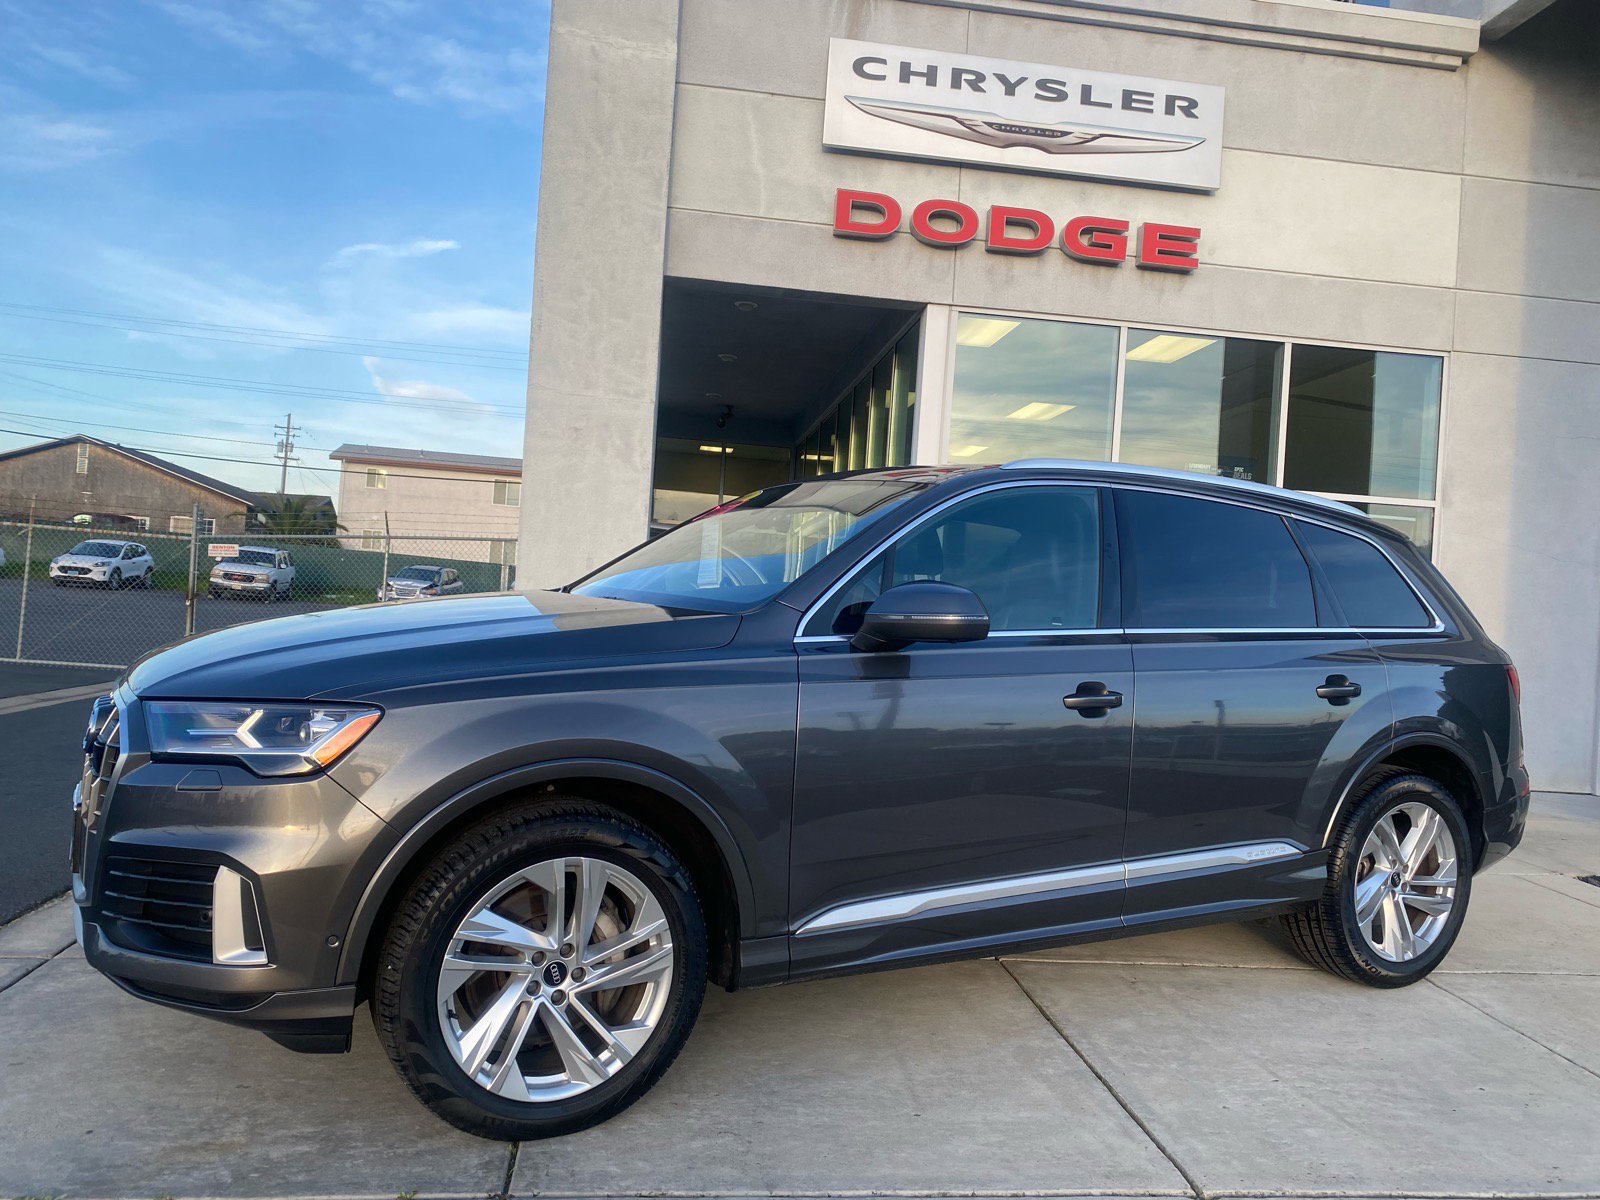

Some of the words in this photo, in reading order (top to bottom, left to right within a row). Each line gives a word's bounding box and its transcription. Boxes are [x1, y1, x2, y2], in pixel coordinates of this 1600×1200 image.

[852, 56, 1200, 119] CHRYSLER
[992, 124, 1061, 136] CHRYSLER
[833, 188, 1202, 274] DODGE
[1233, 472, 1252, 480] DEALS
